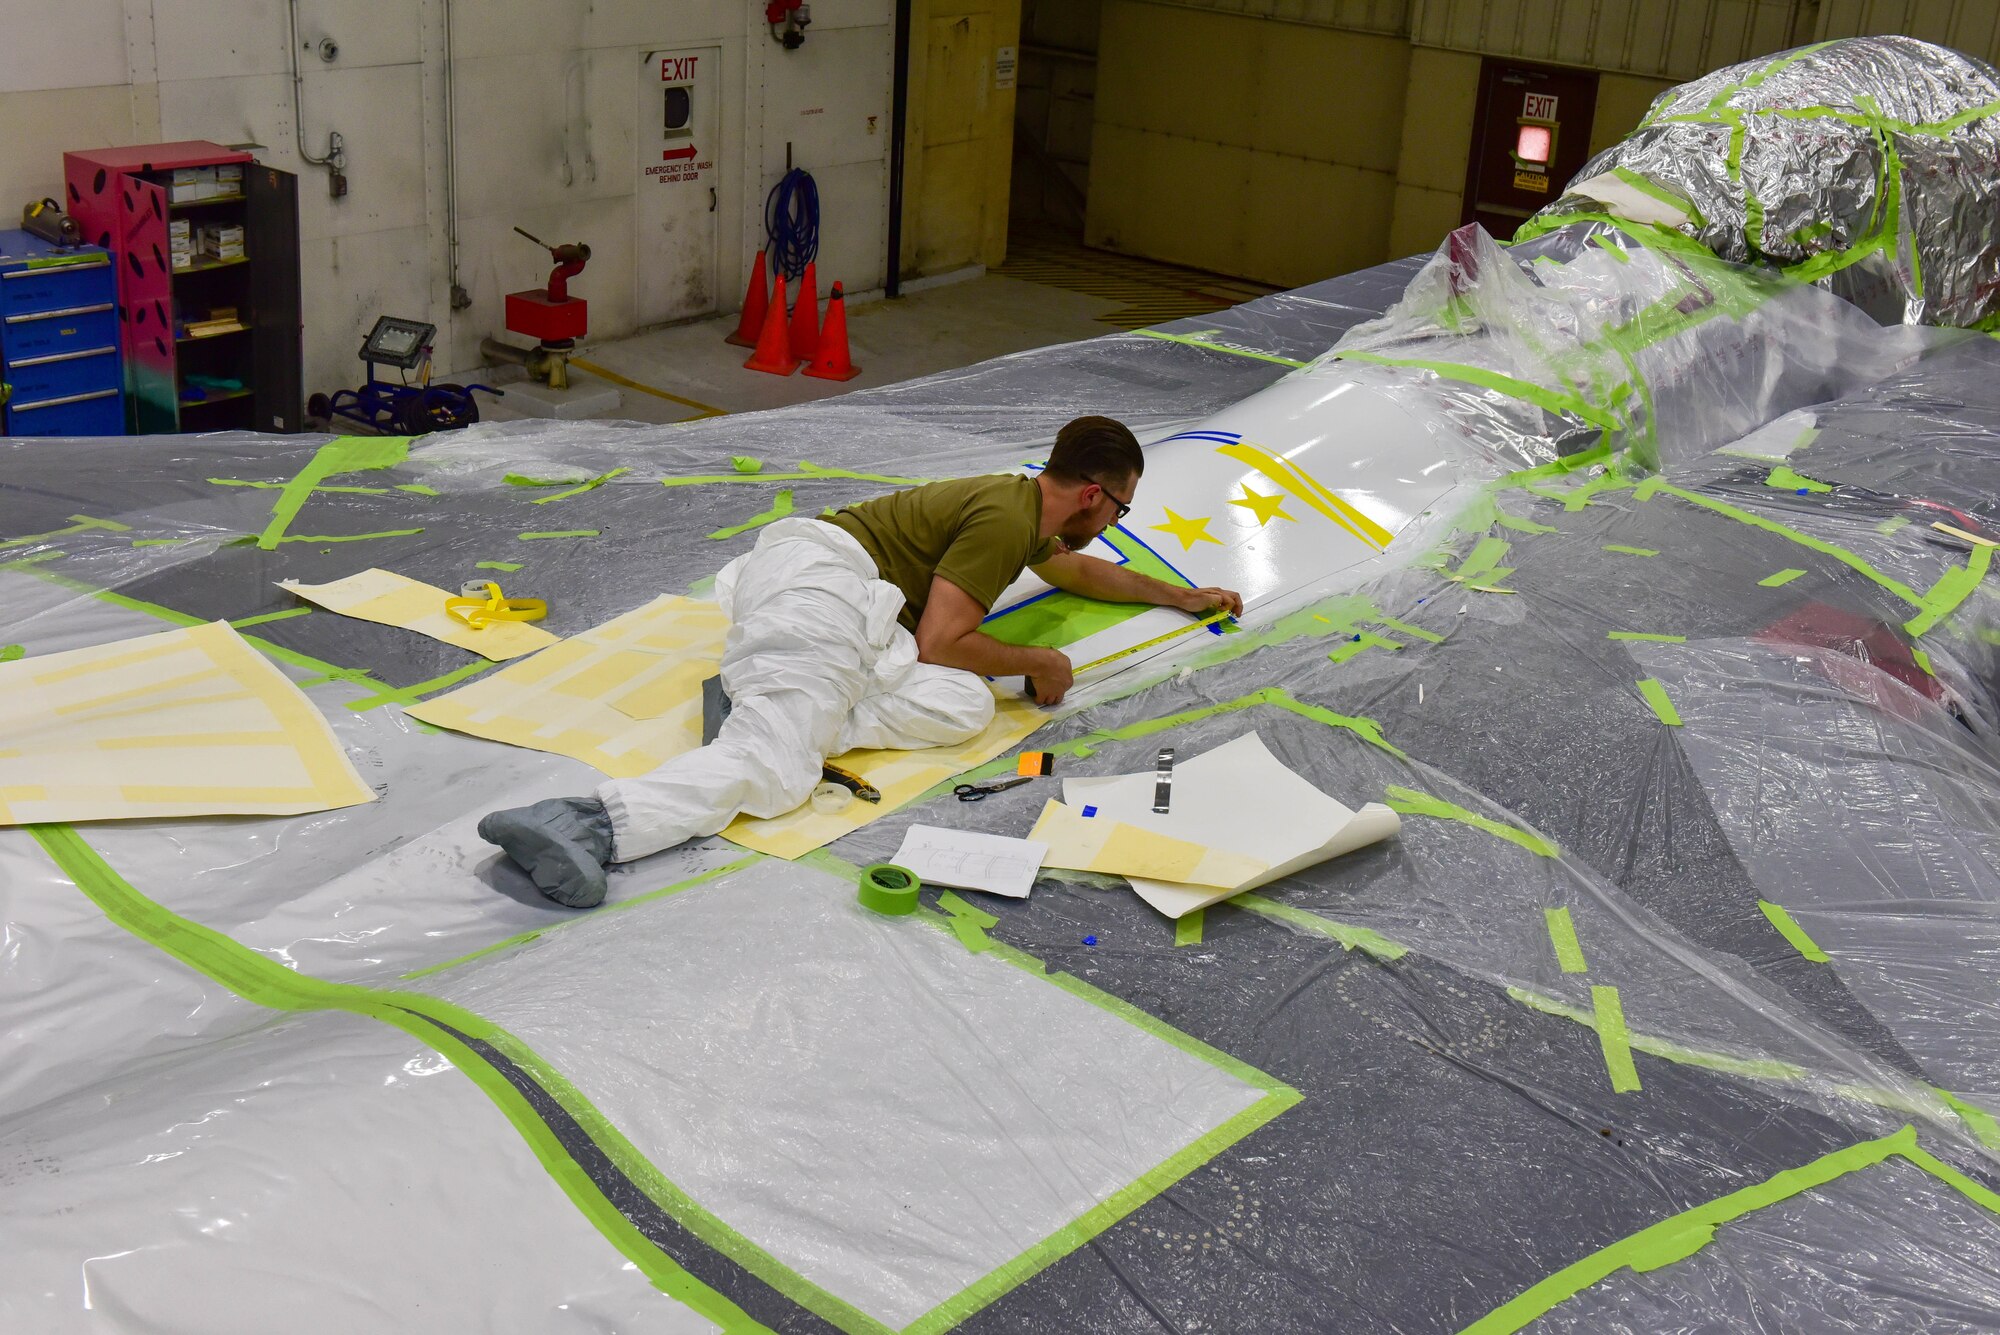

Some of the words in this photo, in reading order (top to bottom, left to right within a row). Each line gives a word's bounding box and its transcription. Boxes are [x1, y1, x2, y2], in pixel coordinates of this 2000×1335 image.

[662, 57, 698, 81] EXIT
[1526, 95, 1554, 119] EXIT
[645, 164, 682, 175] EMERGENCY
[683, 162, 695, 172] EYE
[697, 160, 713, 170] WASH
[659, 173, 681, 183] BEHIND
[683, 172, 698, 181] DOOR
[1516, 170, 1549, 182] CAUTION
